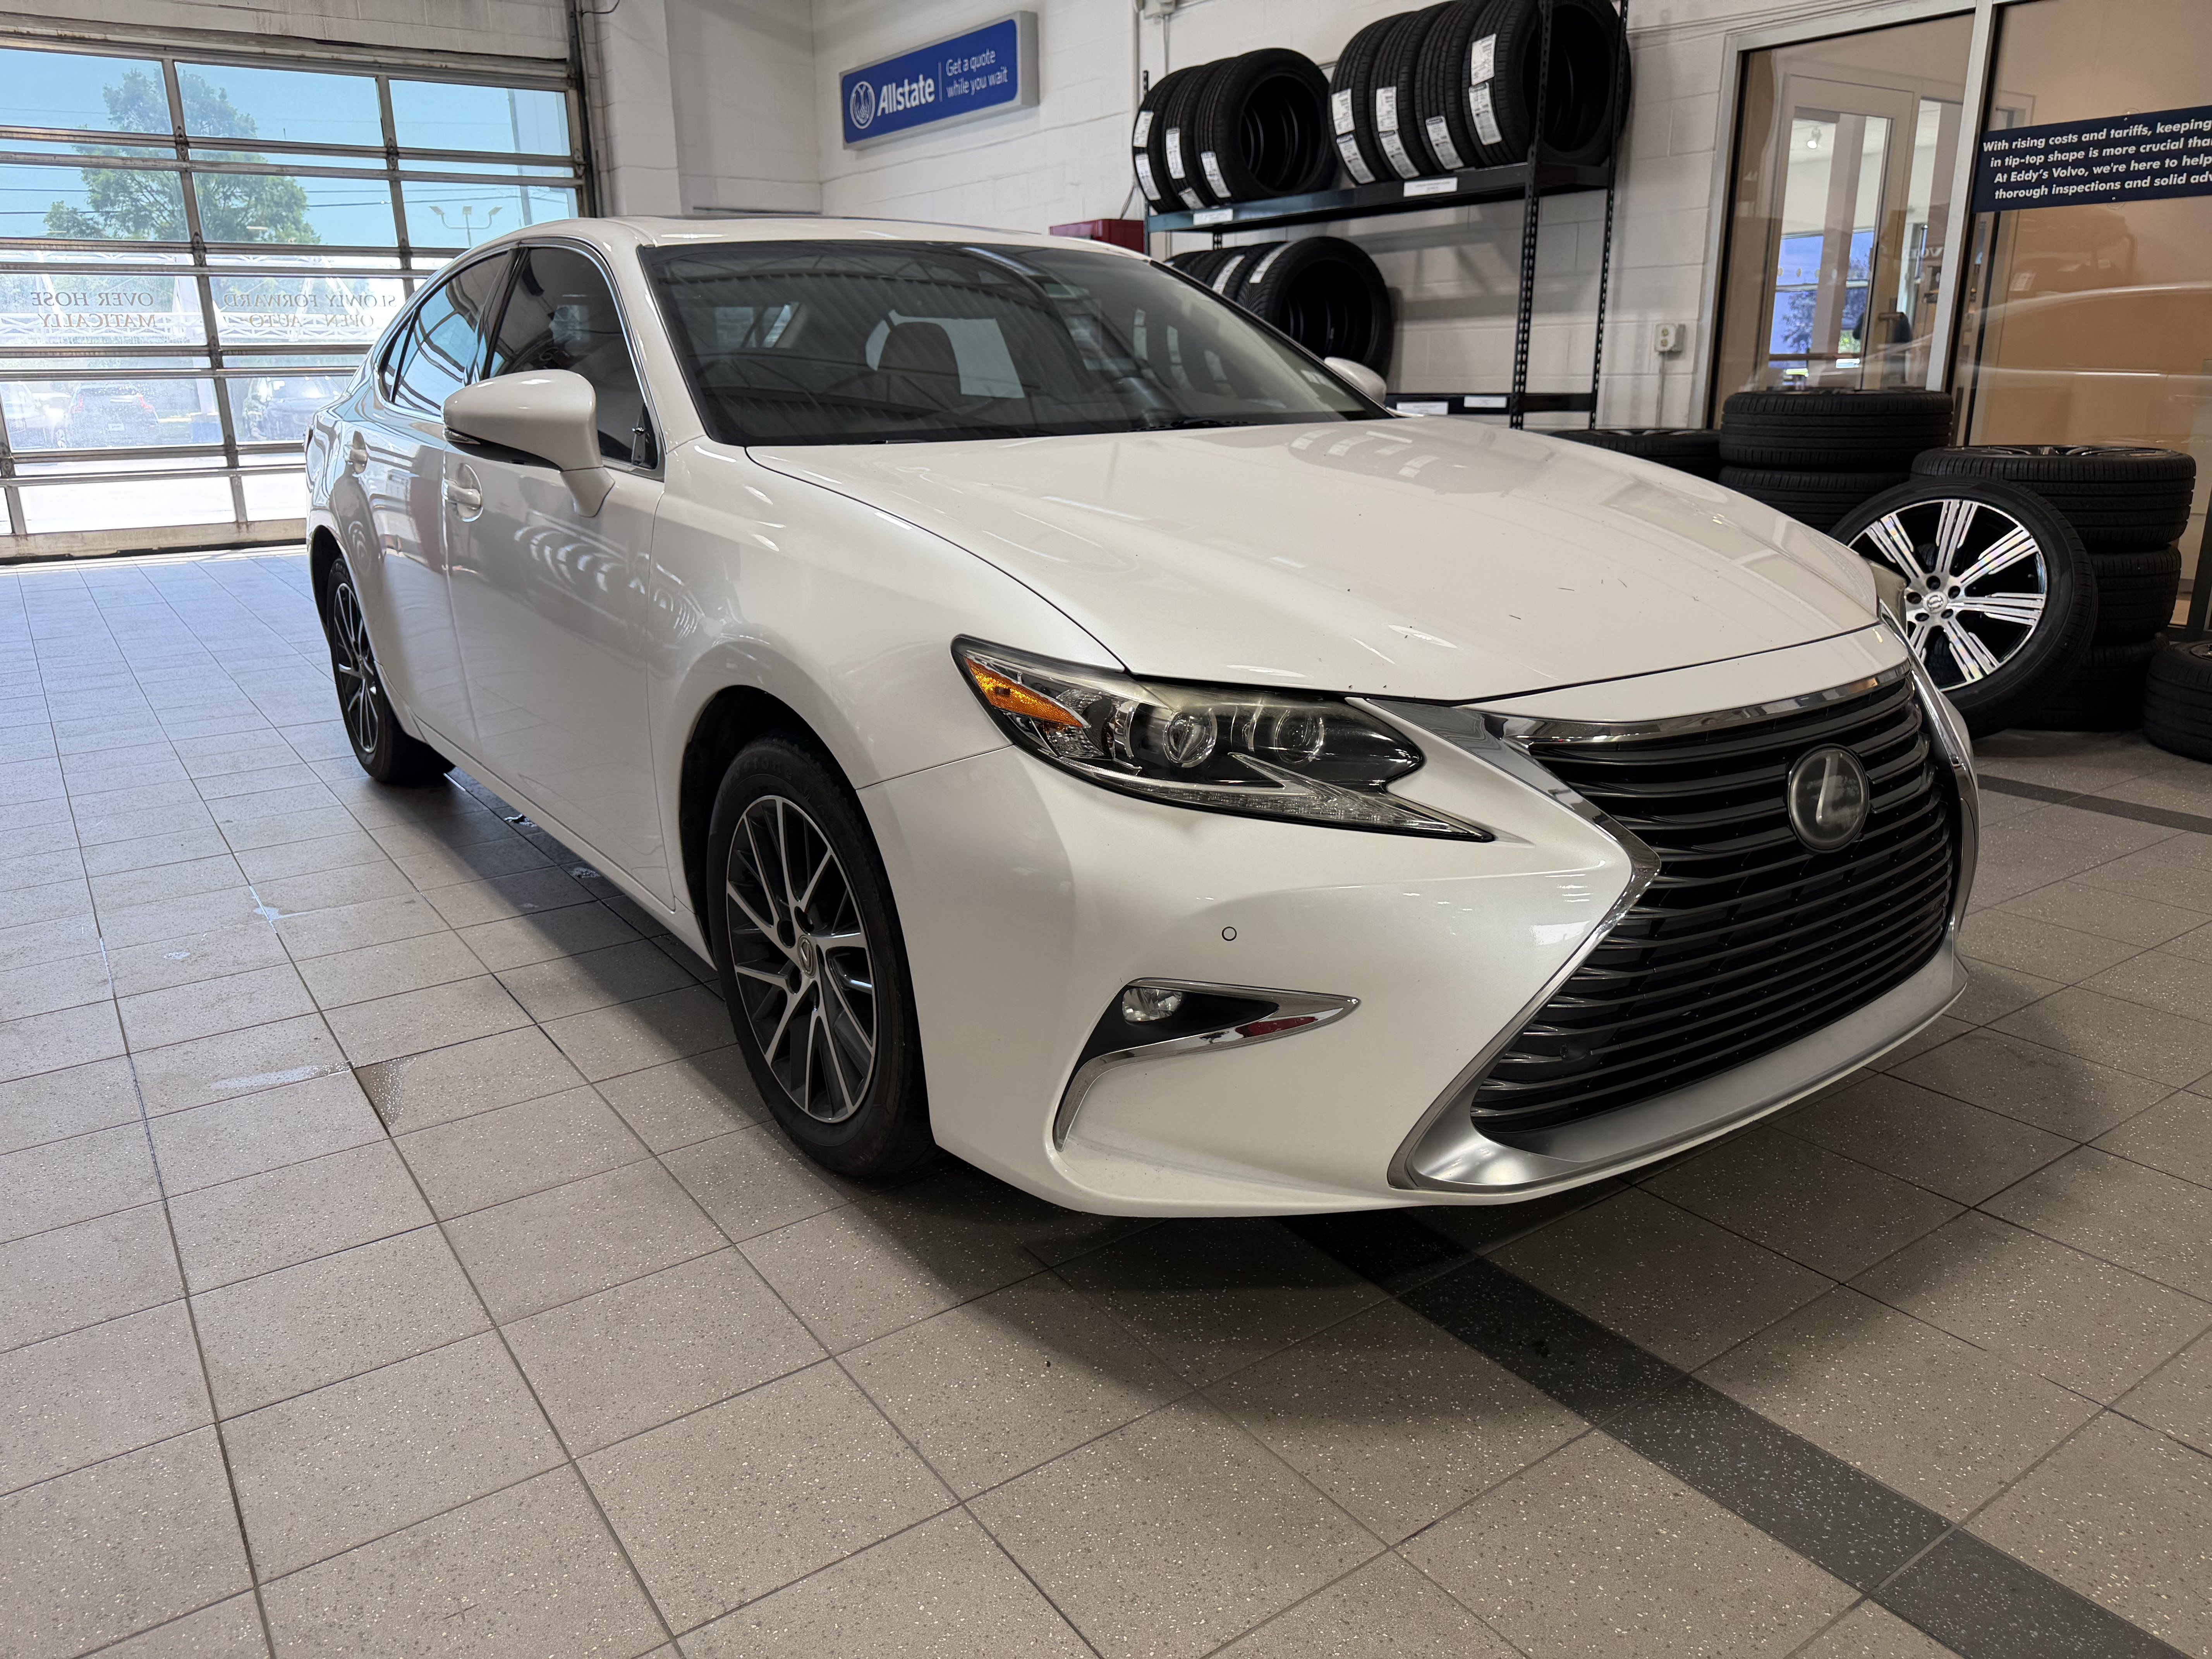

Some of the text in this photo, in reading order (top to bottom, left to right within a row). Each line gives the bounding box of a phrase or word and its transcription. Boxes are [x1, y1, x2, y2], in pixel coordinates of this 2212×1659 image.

[946, 48, 996, 76] Get a quote
[877, 74, 935, 117] Allstate
[946, 66, 1008, 98] while you wait
[1983, 118, 2212, 152] With rising costs and tariffs, keeping
[1990, 136, 2212, 168] in tip-top shape is more crucial tha
[1994, 153, 2212, 183] At Eddy's Volvo, we're here to help
[1995, 185, 2048, 199] thorough
[2052, 180, 2121, 196] inspections
[2124, 176, 2151, 189] and
[2154, 173, 2187, 186] solid
